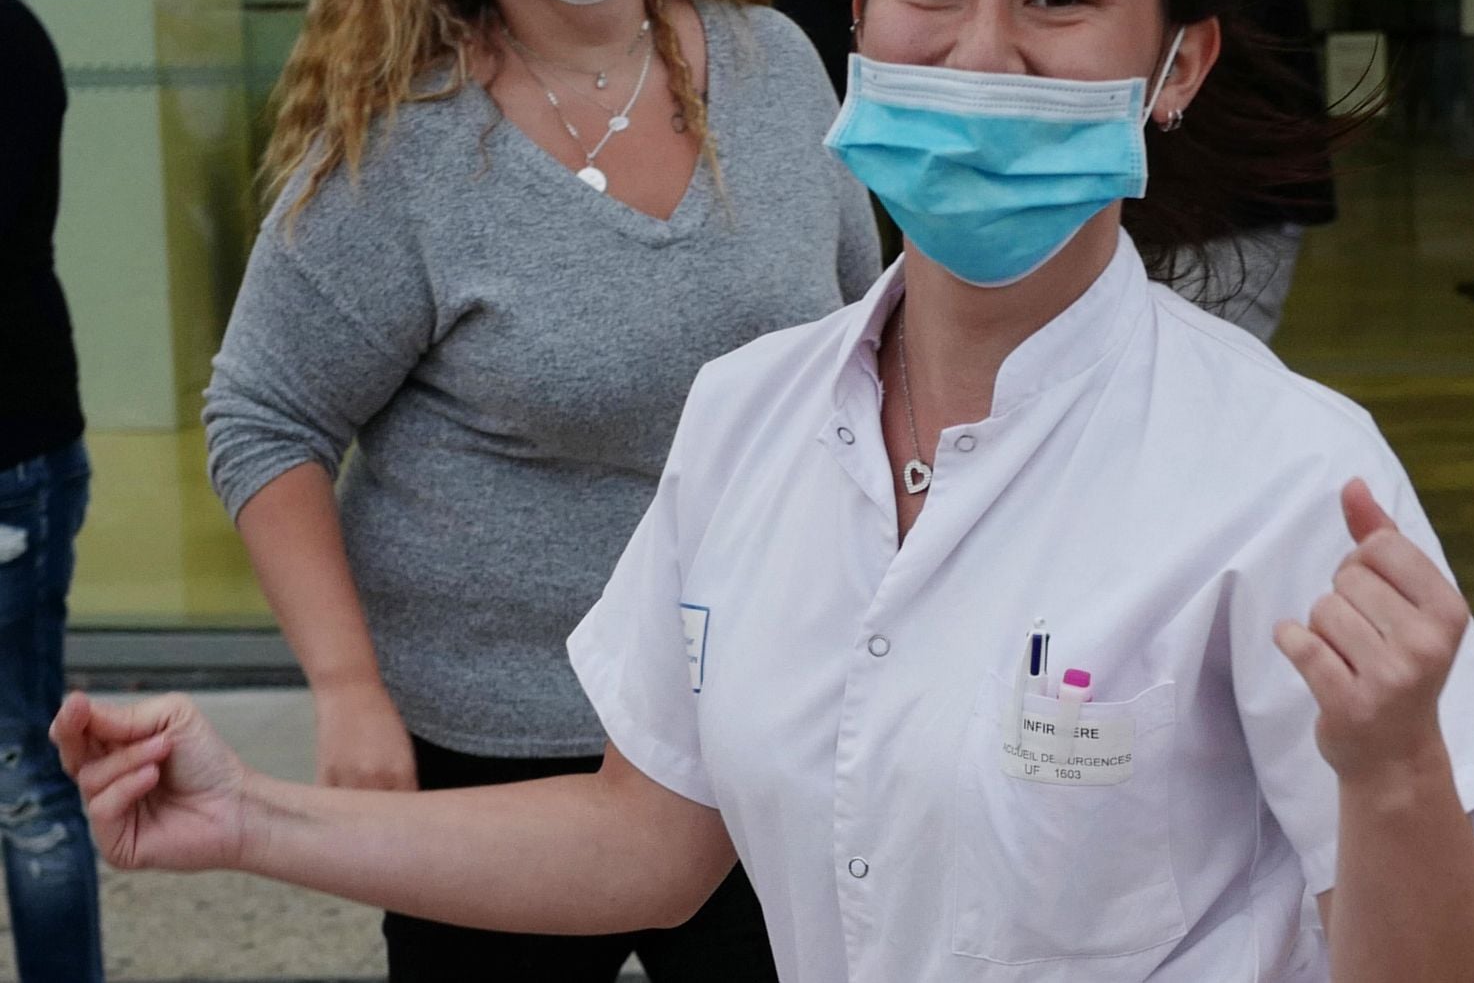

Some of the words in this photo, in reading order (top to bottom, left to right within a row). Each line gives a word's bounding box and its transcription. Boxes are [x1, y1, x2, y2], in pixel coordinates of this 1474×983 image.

[1023, 718, 1100, 739] INFIRERE
[1041, 753, 1056, 764] DE
[1067, 753, 1132, 767] URGENCES
[1024, 763, 1040, 776] UF
[1054, 768, 1081, 780] 1603
